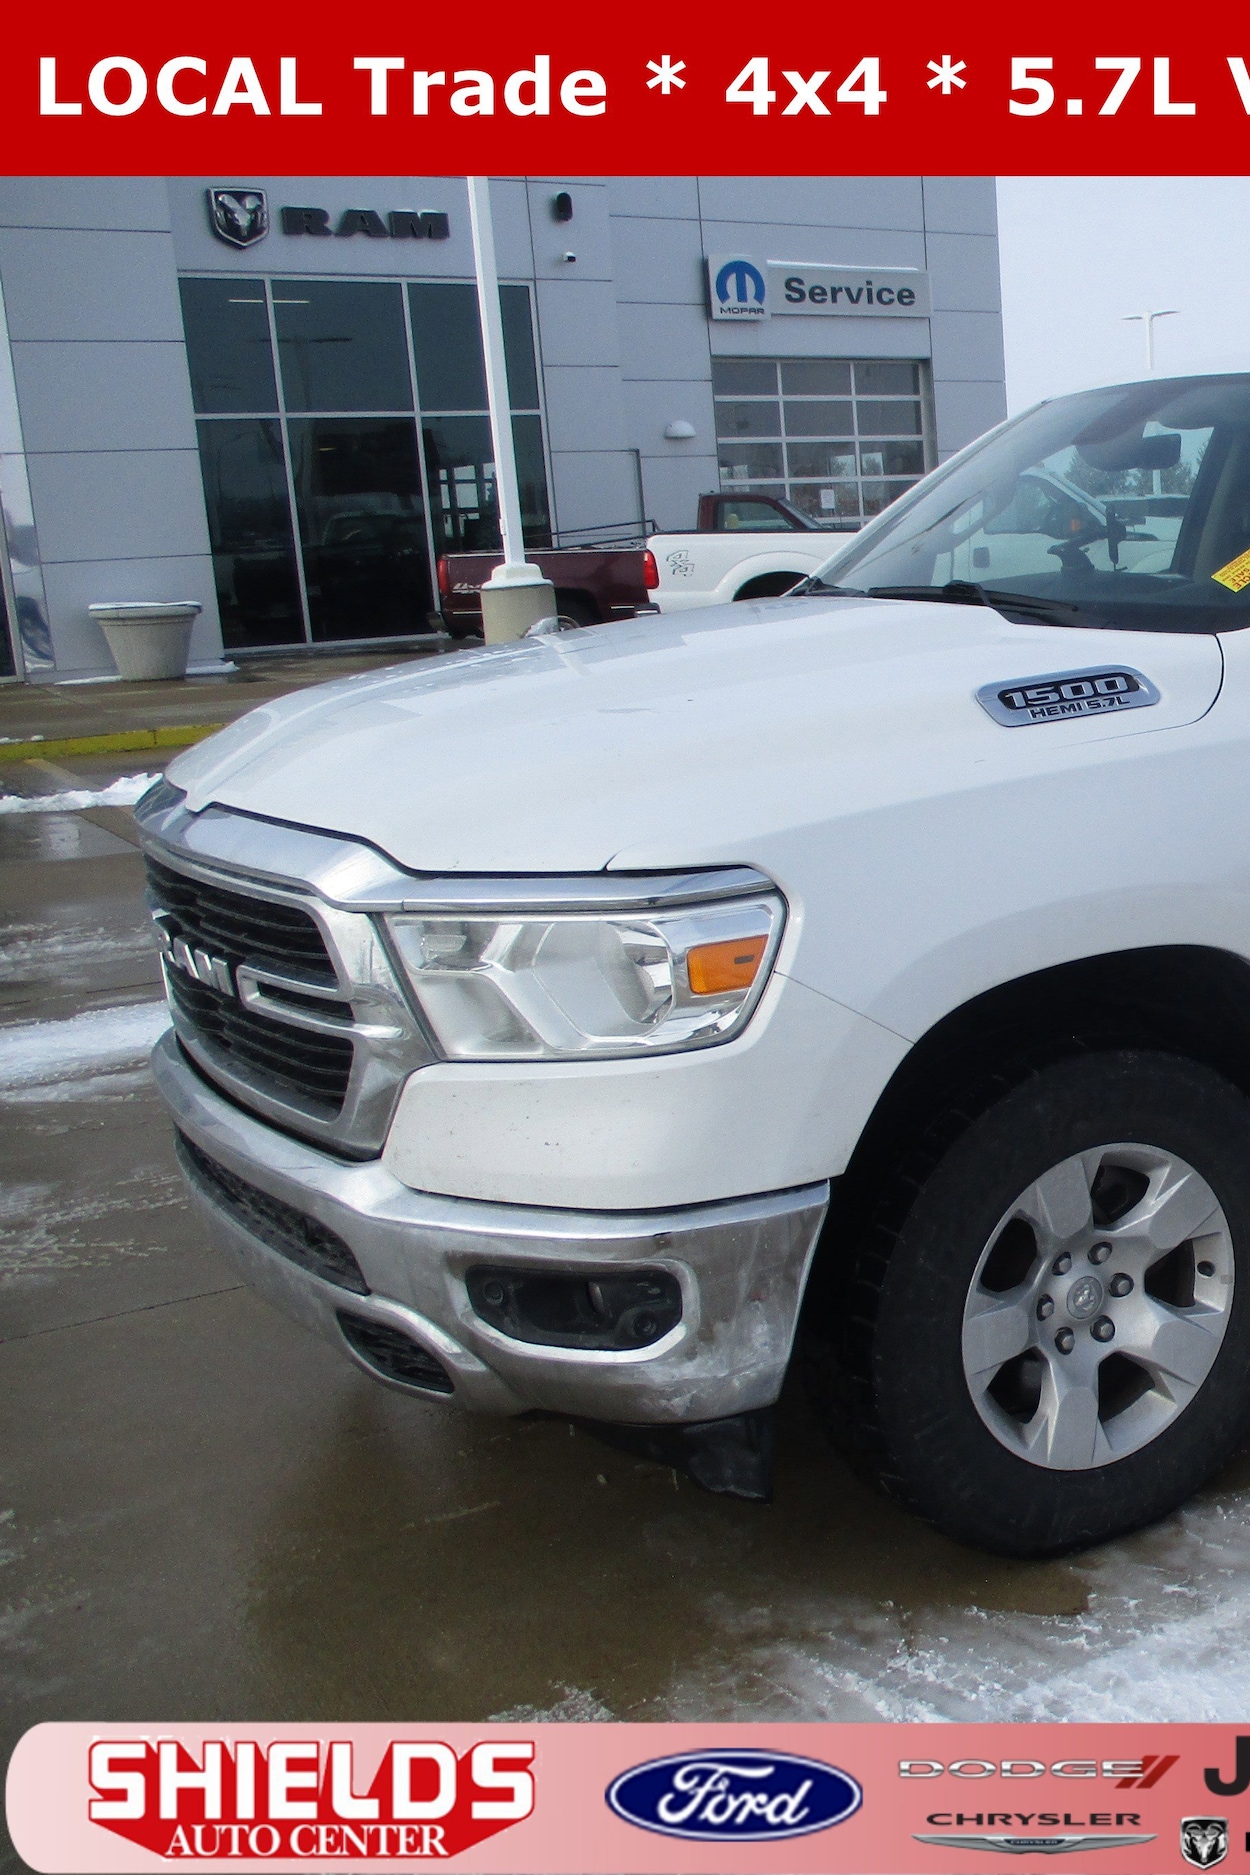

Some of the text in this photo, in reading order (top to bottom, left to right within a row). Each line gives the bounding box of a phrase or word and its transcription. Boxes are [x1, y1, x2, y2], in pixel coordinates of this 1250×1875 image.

[281, 206, 449, 239] RAM
[784, 277, 916, 307] Service
[720, 307, 766, 315] MOPAR
[1230, 567, 1250, 583] SALE
[1005, 676, 1129, 709] 1500
[1030, 695, 1131, 719] HEMI 5.7L
